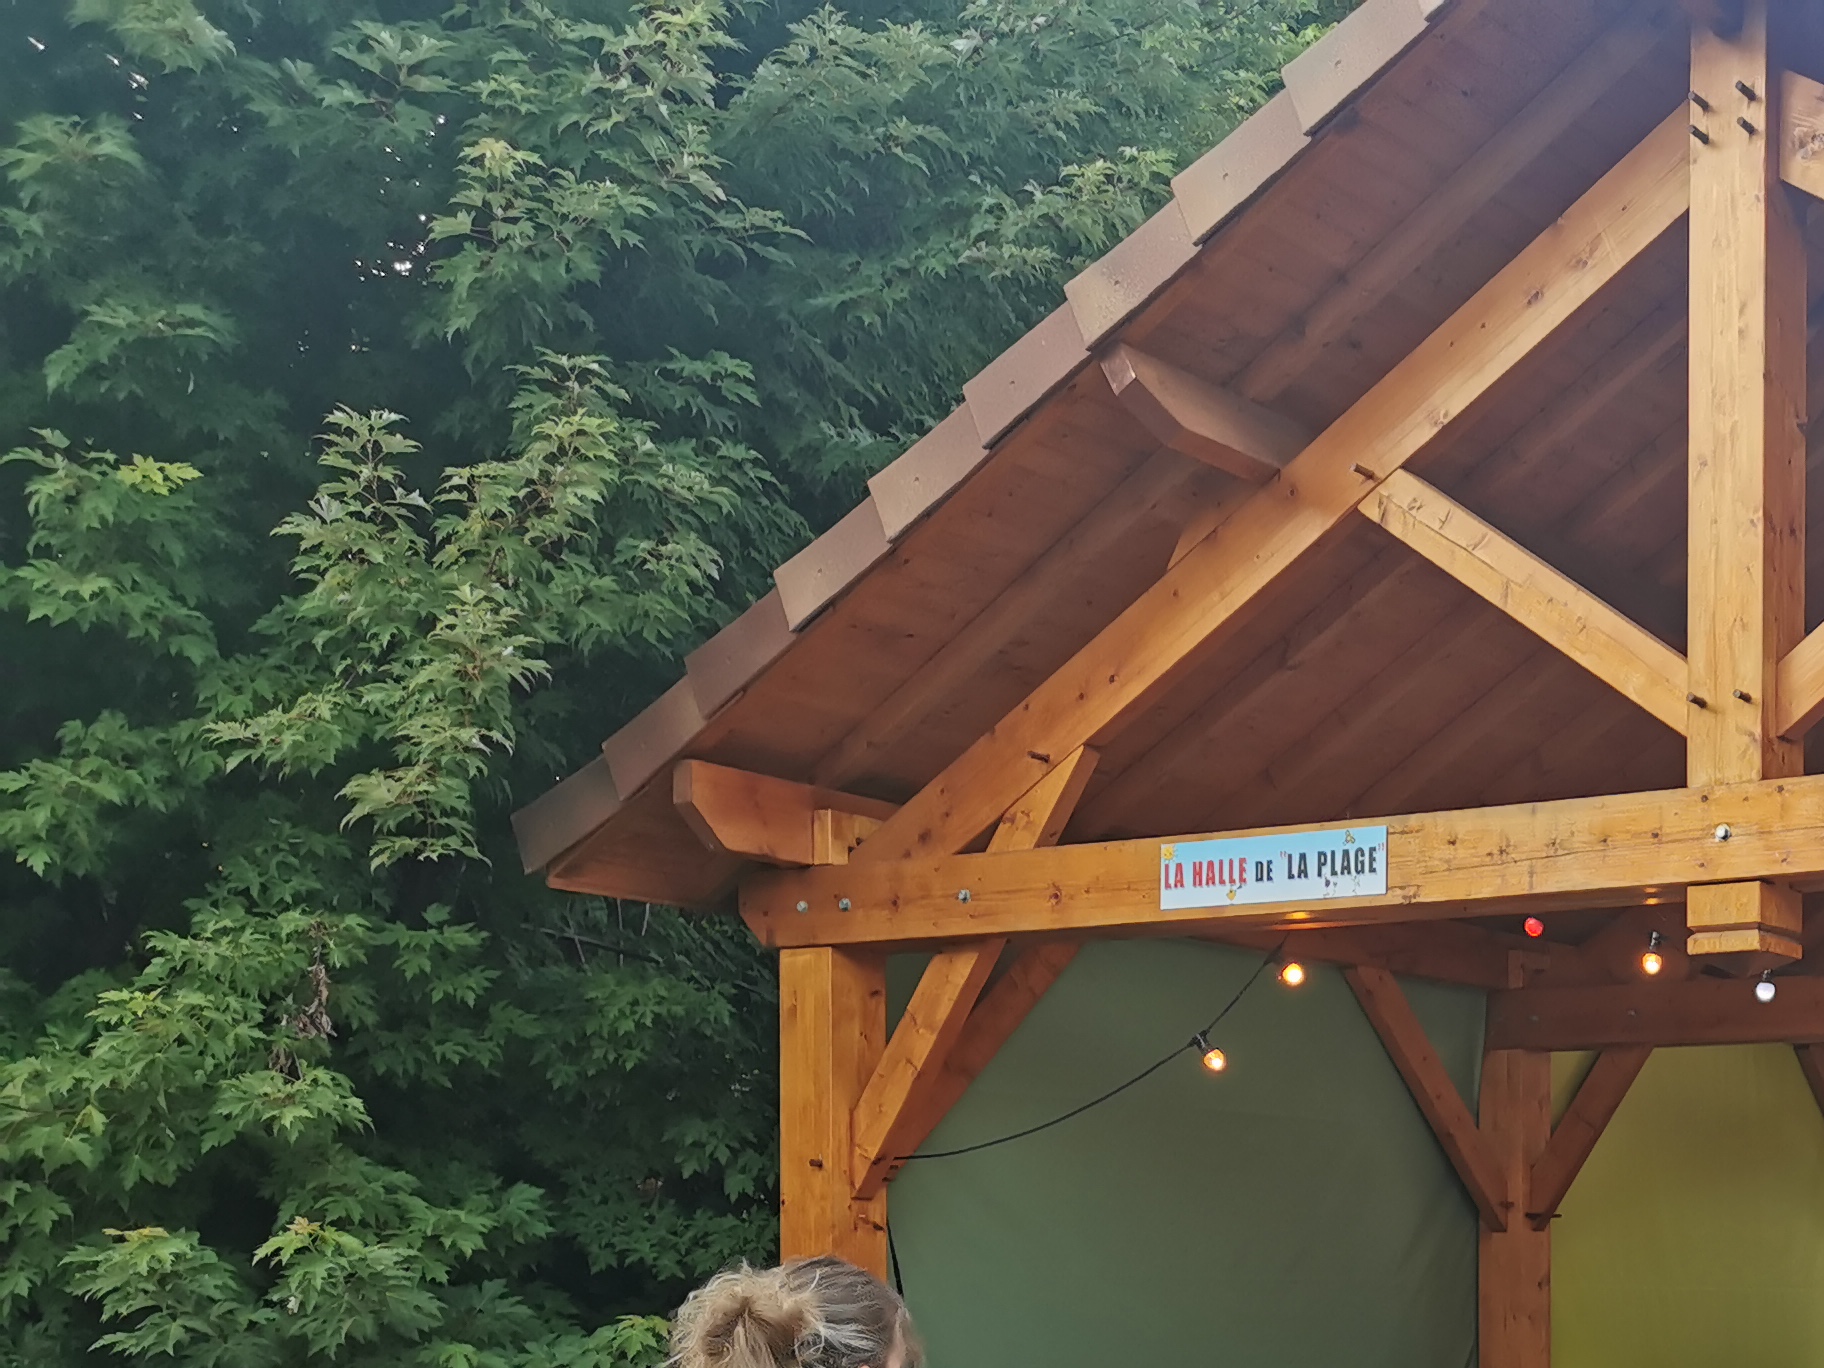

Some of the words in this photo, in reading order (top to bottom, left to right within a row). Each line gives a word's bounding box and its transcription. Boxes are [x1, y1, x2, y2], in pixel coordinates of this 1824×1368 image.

[1164, 862, 1185, 890] LA
[1192, 857, 1248, 887] HALLE
[1255, 859, 1274, 882] DE
